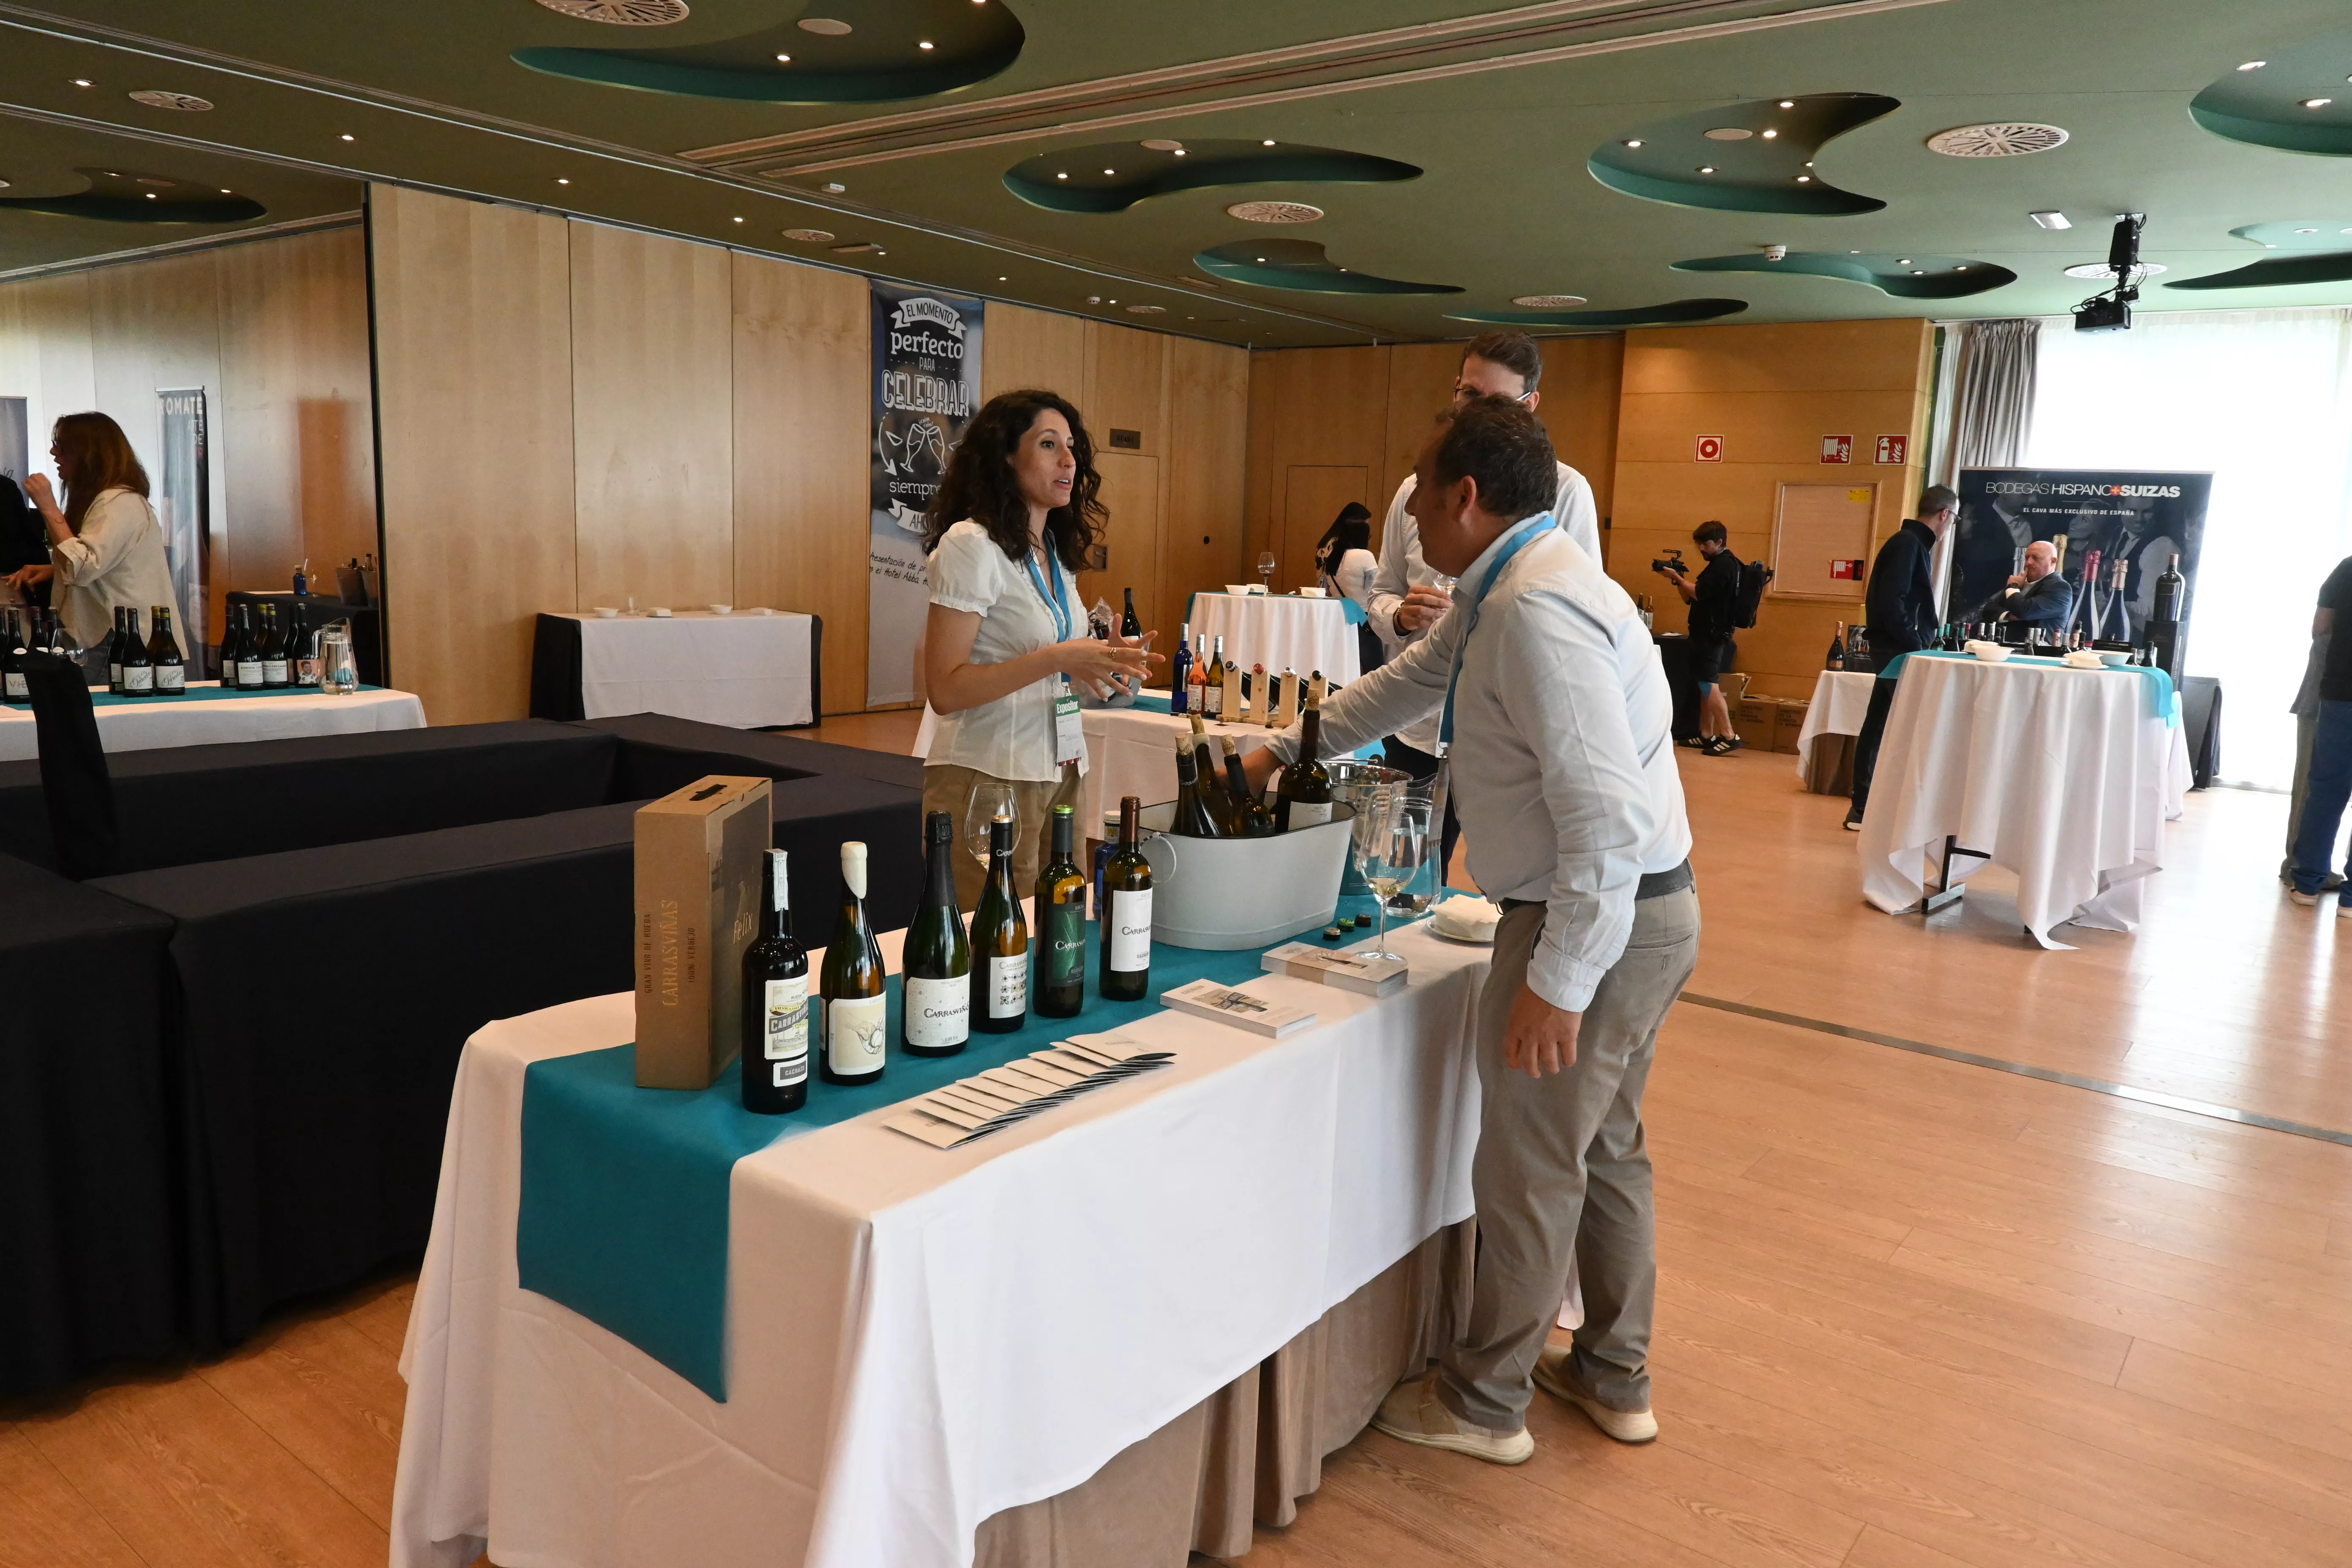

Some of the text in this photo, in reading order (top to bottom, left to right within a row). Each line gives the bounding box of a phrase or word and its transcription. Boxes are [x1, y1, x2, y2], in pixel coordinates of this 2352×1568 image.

[906, 302, 953, 324] EL MOMENTO
[890, 331, 963, 359] perfecto
[919, 357, 935, 372] PARA
[882, 369, 969, 417] CELEBRAR
[1985, 482, 2049, 494] BODEGAS
[2120, 485, 2181, 498] SUIZAS
[884, 567, 901, 579] Hotel
[903, 571, 919, 584] Abba
[908, 561, 916, 570] de
[917, 566, 926, 575] pr
[1056, 700, 1078, 714] Expositor
[733, 912, 752, 944] Félix
[660, 900, 678, 1006] CARRASVIÑAS
[644, 974, 652, 993] GRAN
